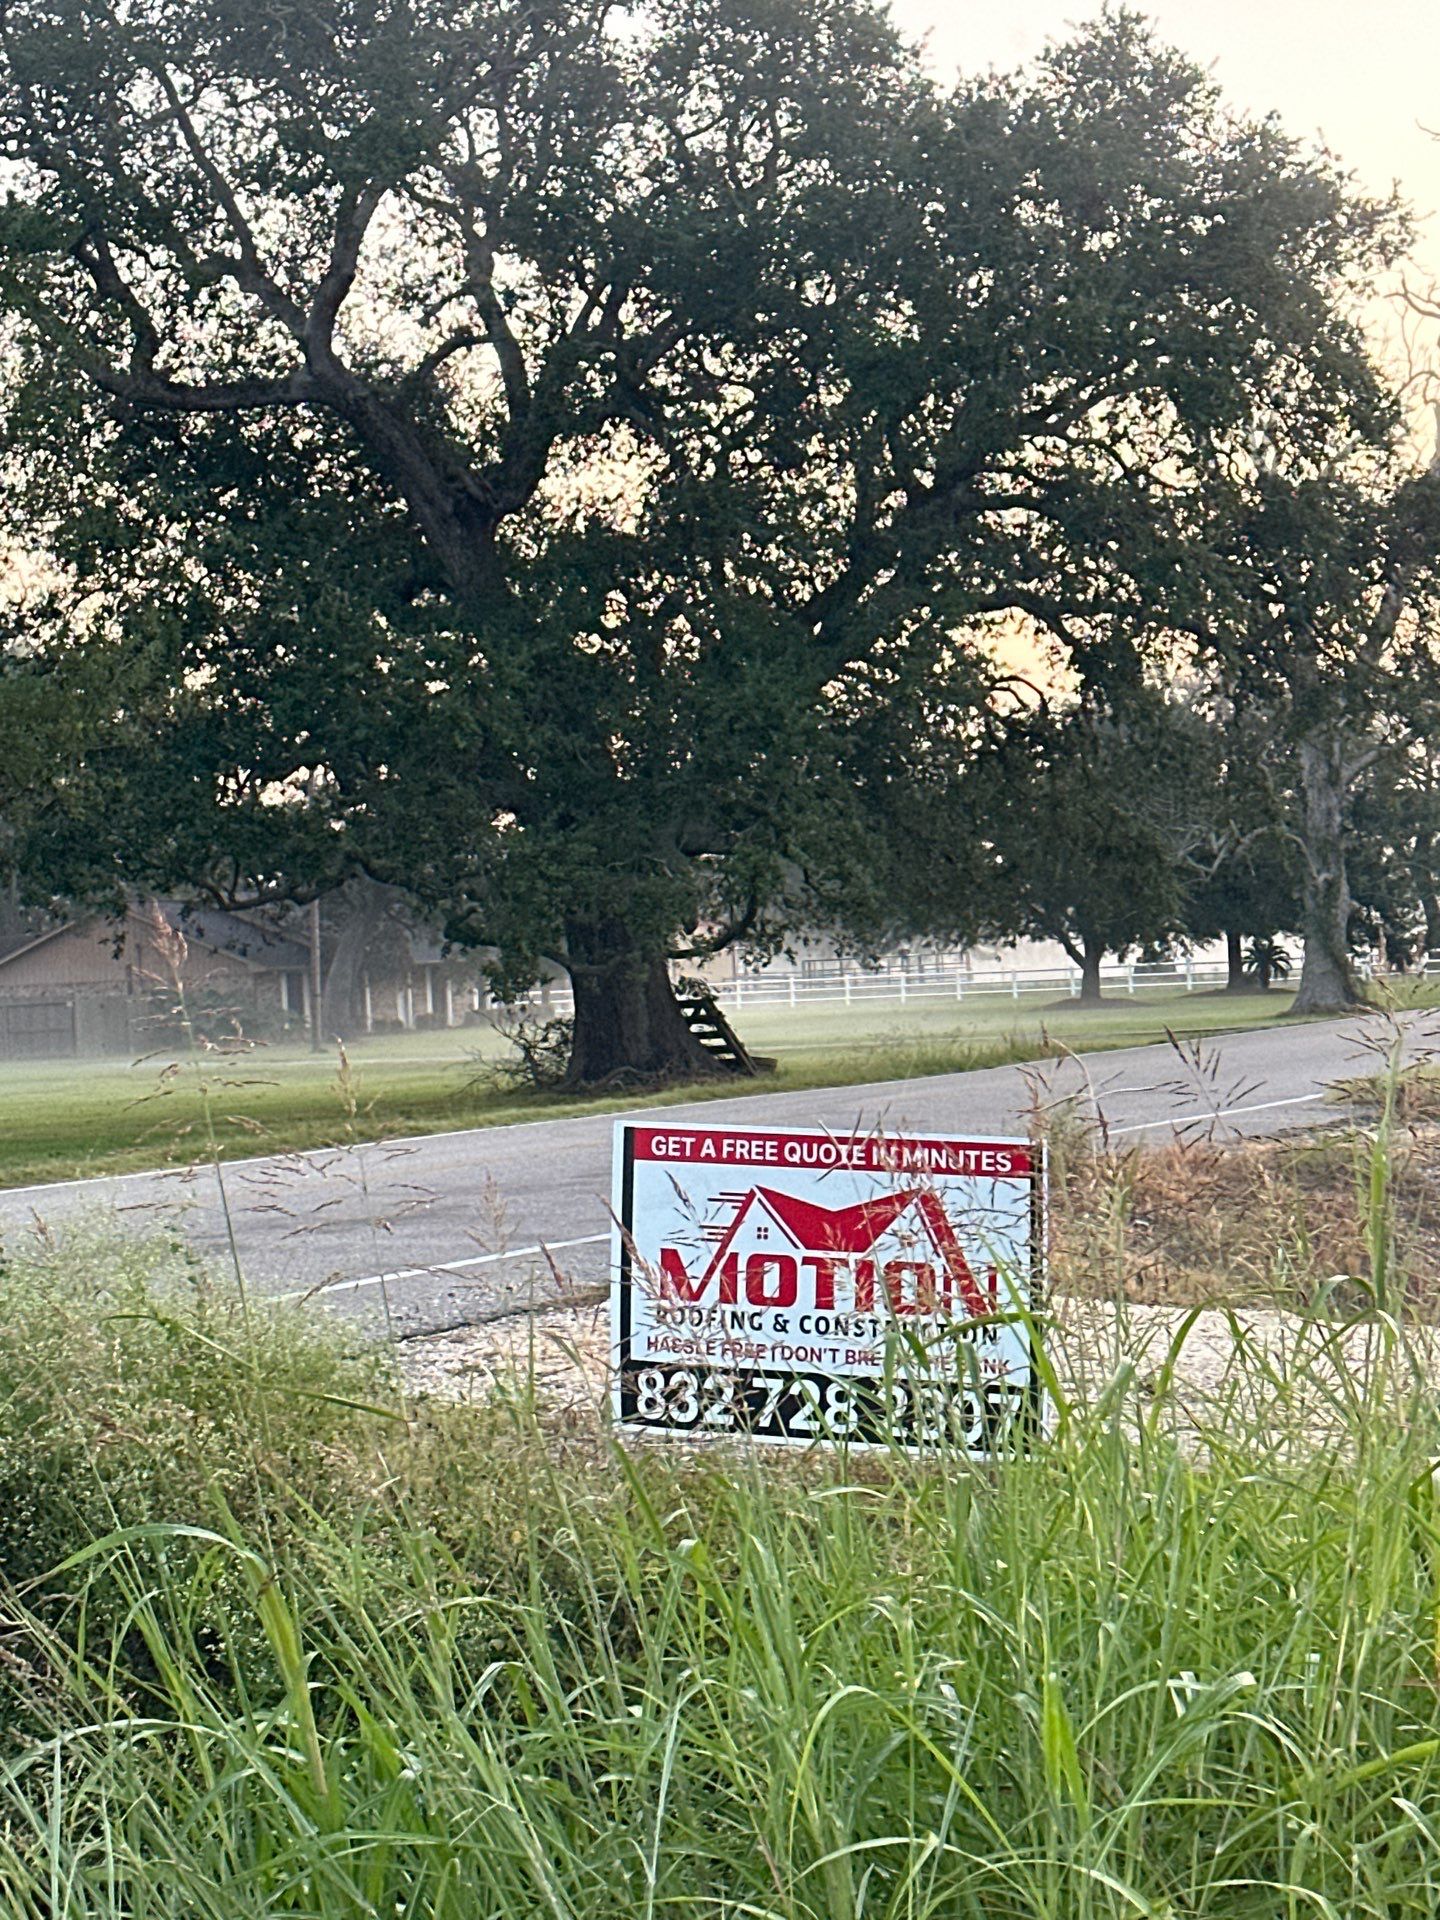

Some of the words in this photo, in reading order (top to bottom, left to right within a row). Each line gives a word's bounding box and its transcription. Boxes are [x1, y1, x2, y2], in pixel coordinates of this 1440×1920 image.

[651, 1135, 695, 1158] GET
[700, 1138, 717, 1159] A
[722, 1139, 779, 1162] FREE
[784, 1143, 866, 1166] QUOTE
[872, 1147, 897, 1167] IN
[902, 1147, 1012, 1173] MINUTES
[660, 1248, 998, 1318] MOTION
[772, 1313, 790, 1334] &
[781, 1346, 840, 1364] DON'T
[637, 1368, 734, 1425] 832
[752, 1377, 859, 1434] 728
